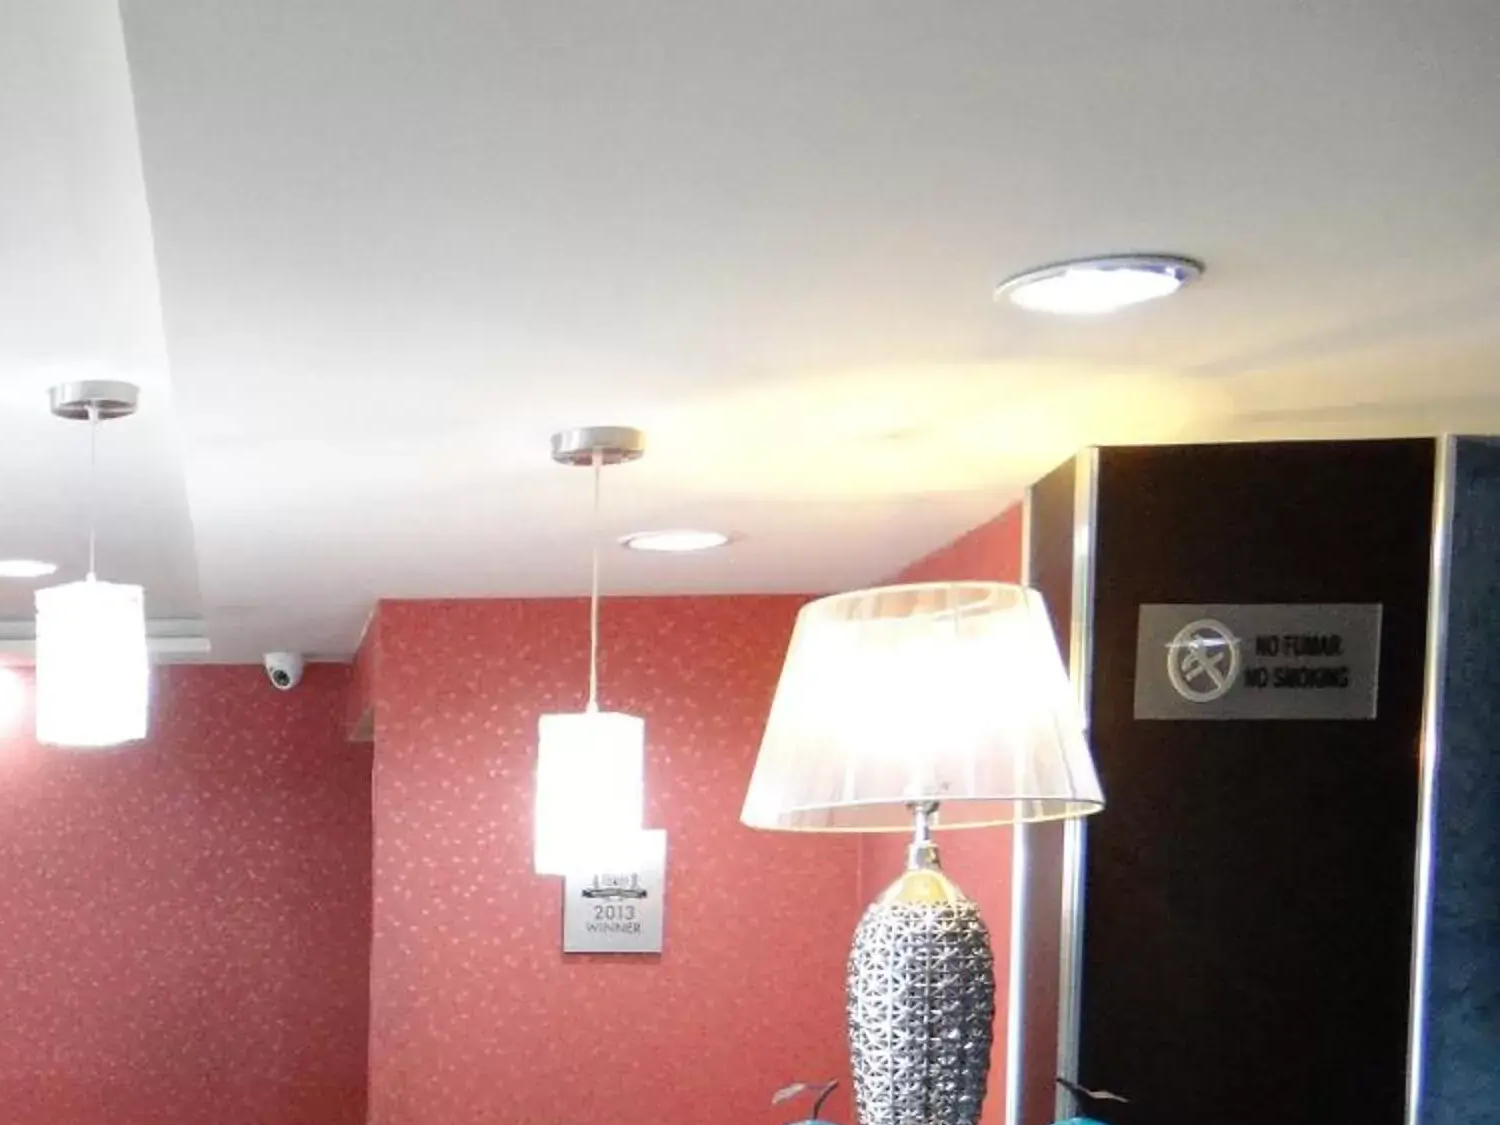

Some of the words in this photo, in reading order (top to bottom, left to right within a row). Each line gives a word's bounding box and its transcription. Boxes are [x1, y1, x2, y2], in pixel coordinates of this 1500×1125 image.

[1256, 635, 1279, 656] NO
[1284, 635, 1344, 656] FUMAR
[1245, 667, 1268, 688] NO
[1274, 667, 1349, 688] SMOKING
[593, 905, 636, 920] 2013
[586, 922, 641, 935] WINNER
